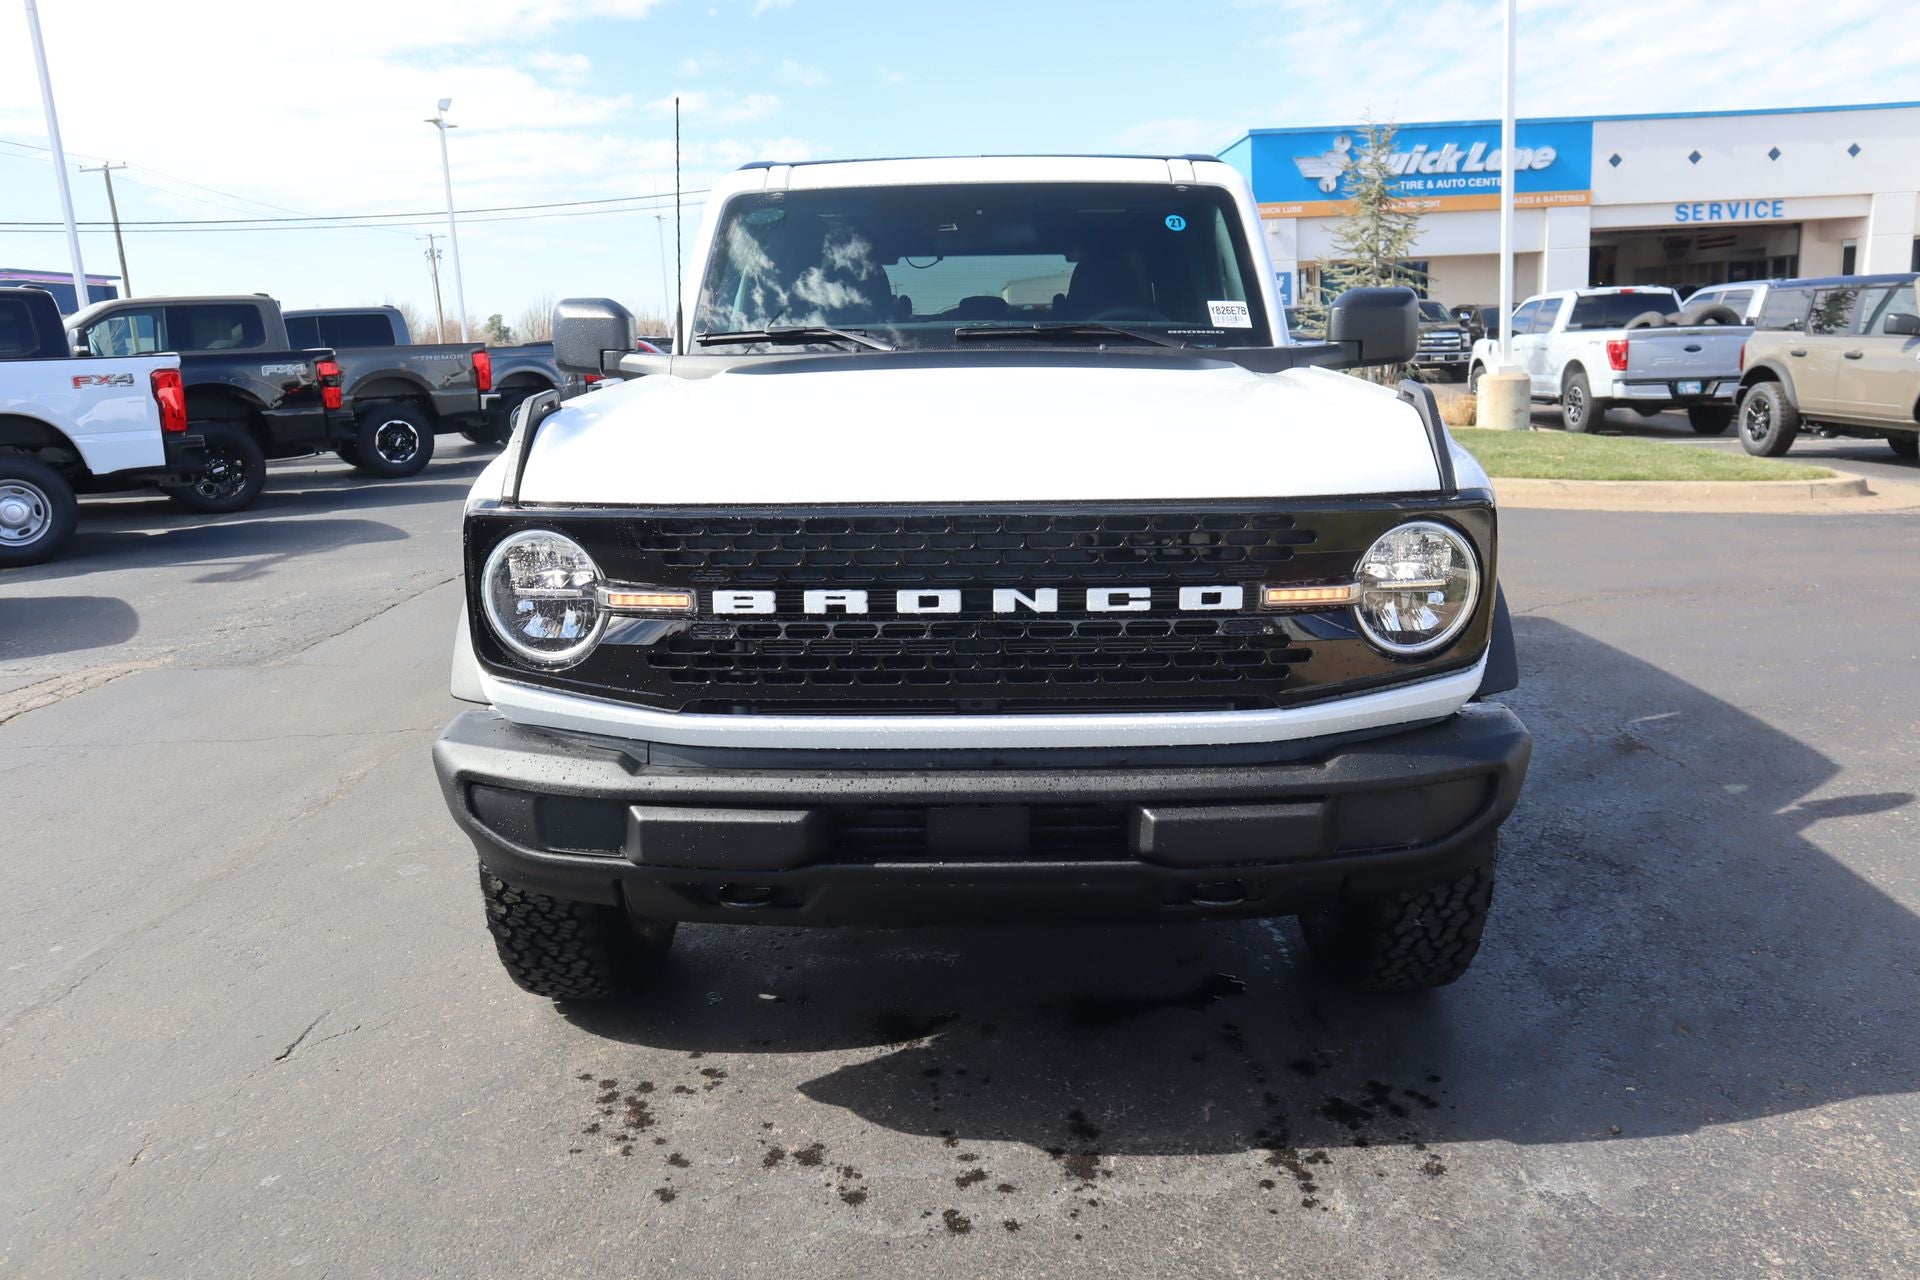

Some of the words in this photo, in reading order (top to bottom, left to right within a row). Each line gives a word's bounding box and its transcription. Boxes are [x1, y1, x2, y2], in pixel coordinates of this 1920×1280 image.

[1401, 180, 1425, 190] TIRE
[1427, 180, 1434, 189] &
[1436, 178, 1466, 188] AUTO
[1468, 177, 1503, 187] CENTE
[1675, 200, 1785, 222] SERVICE
[261, 363, 306, 377] FX4
[72, 373, 135, 389] FX4
[712, 585, 1244, 614] BRONCO
